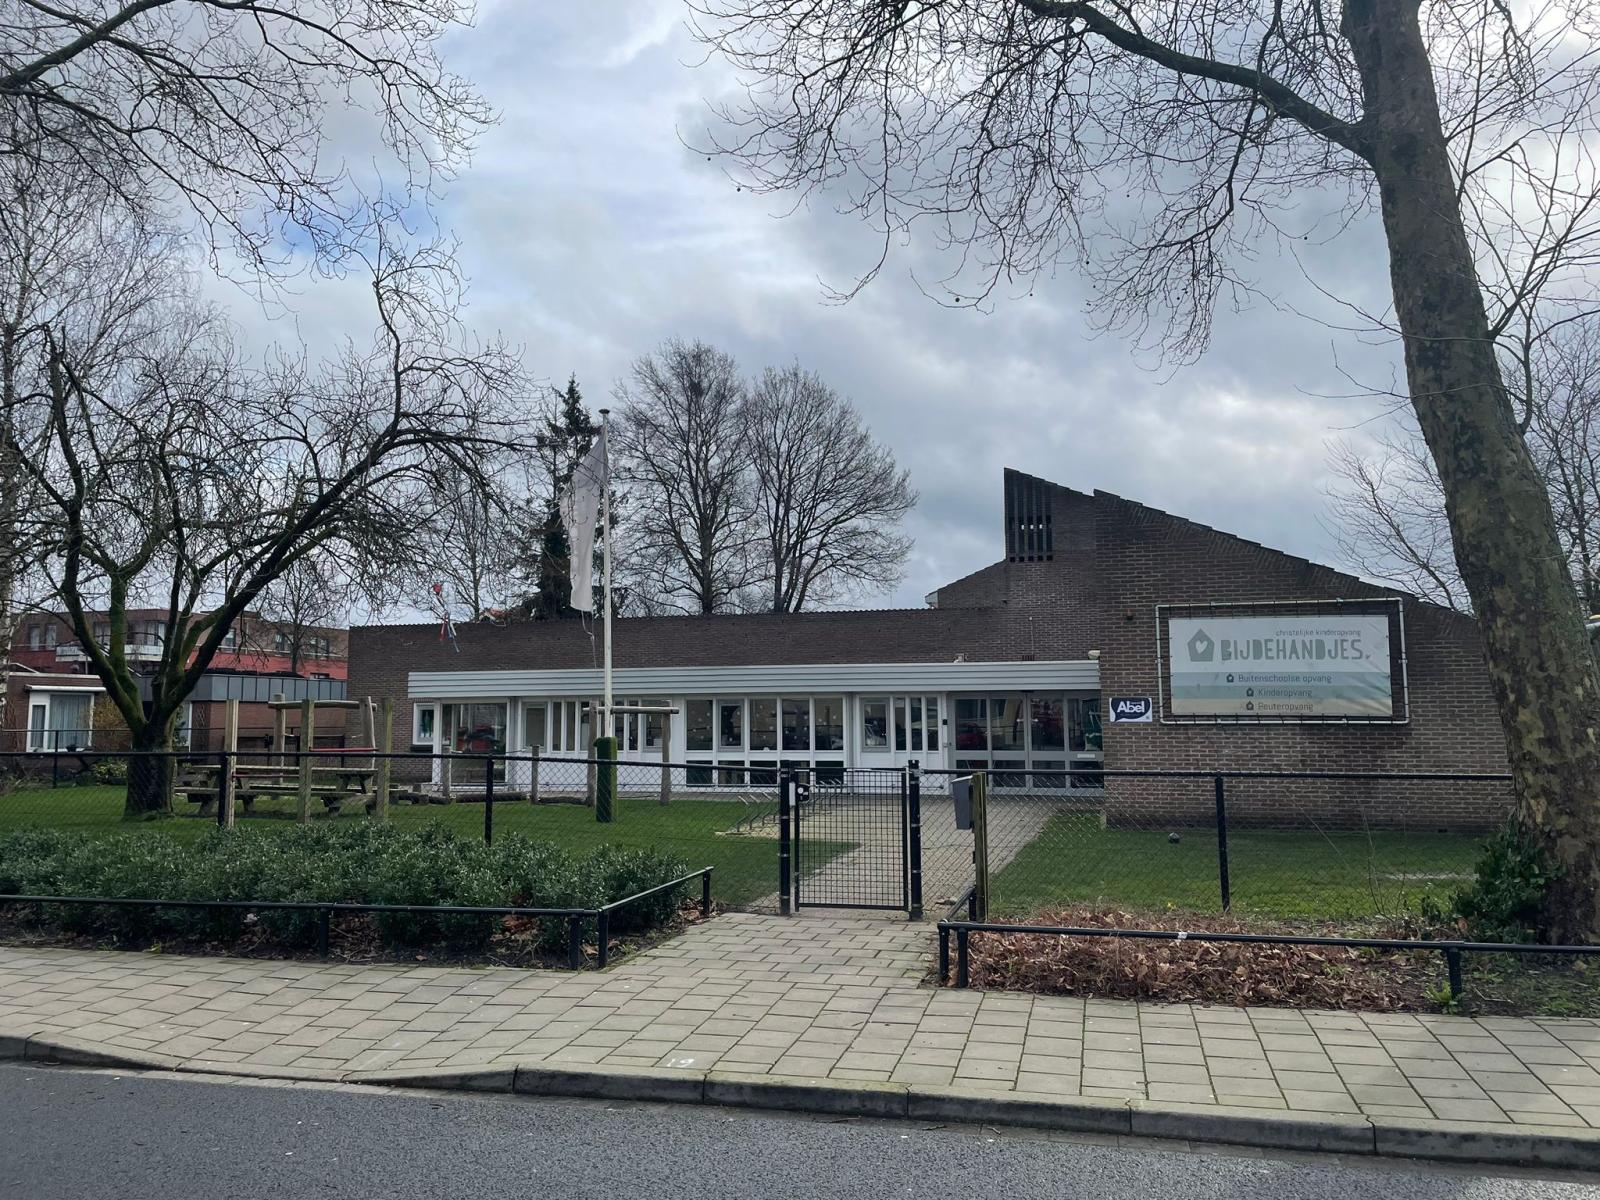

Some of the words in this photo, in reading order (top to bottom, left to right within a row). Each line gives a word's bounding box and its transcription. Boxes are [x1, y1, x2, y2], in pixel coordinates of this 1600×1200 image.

[1303, 675, 1332, 684] opvang
[1258, 688, 1313, 697] Kinderopvang
[1117, 701, 1145, 713] Abel
[1258, 702, 1314, 712] Peuteropvang
